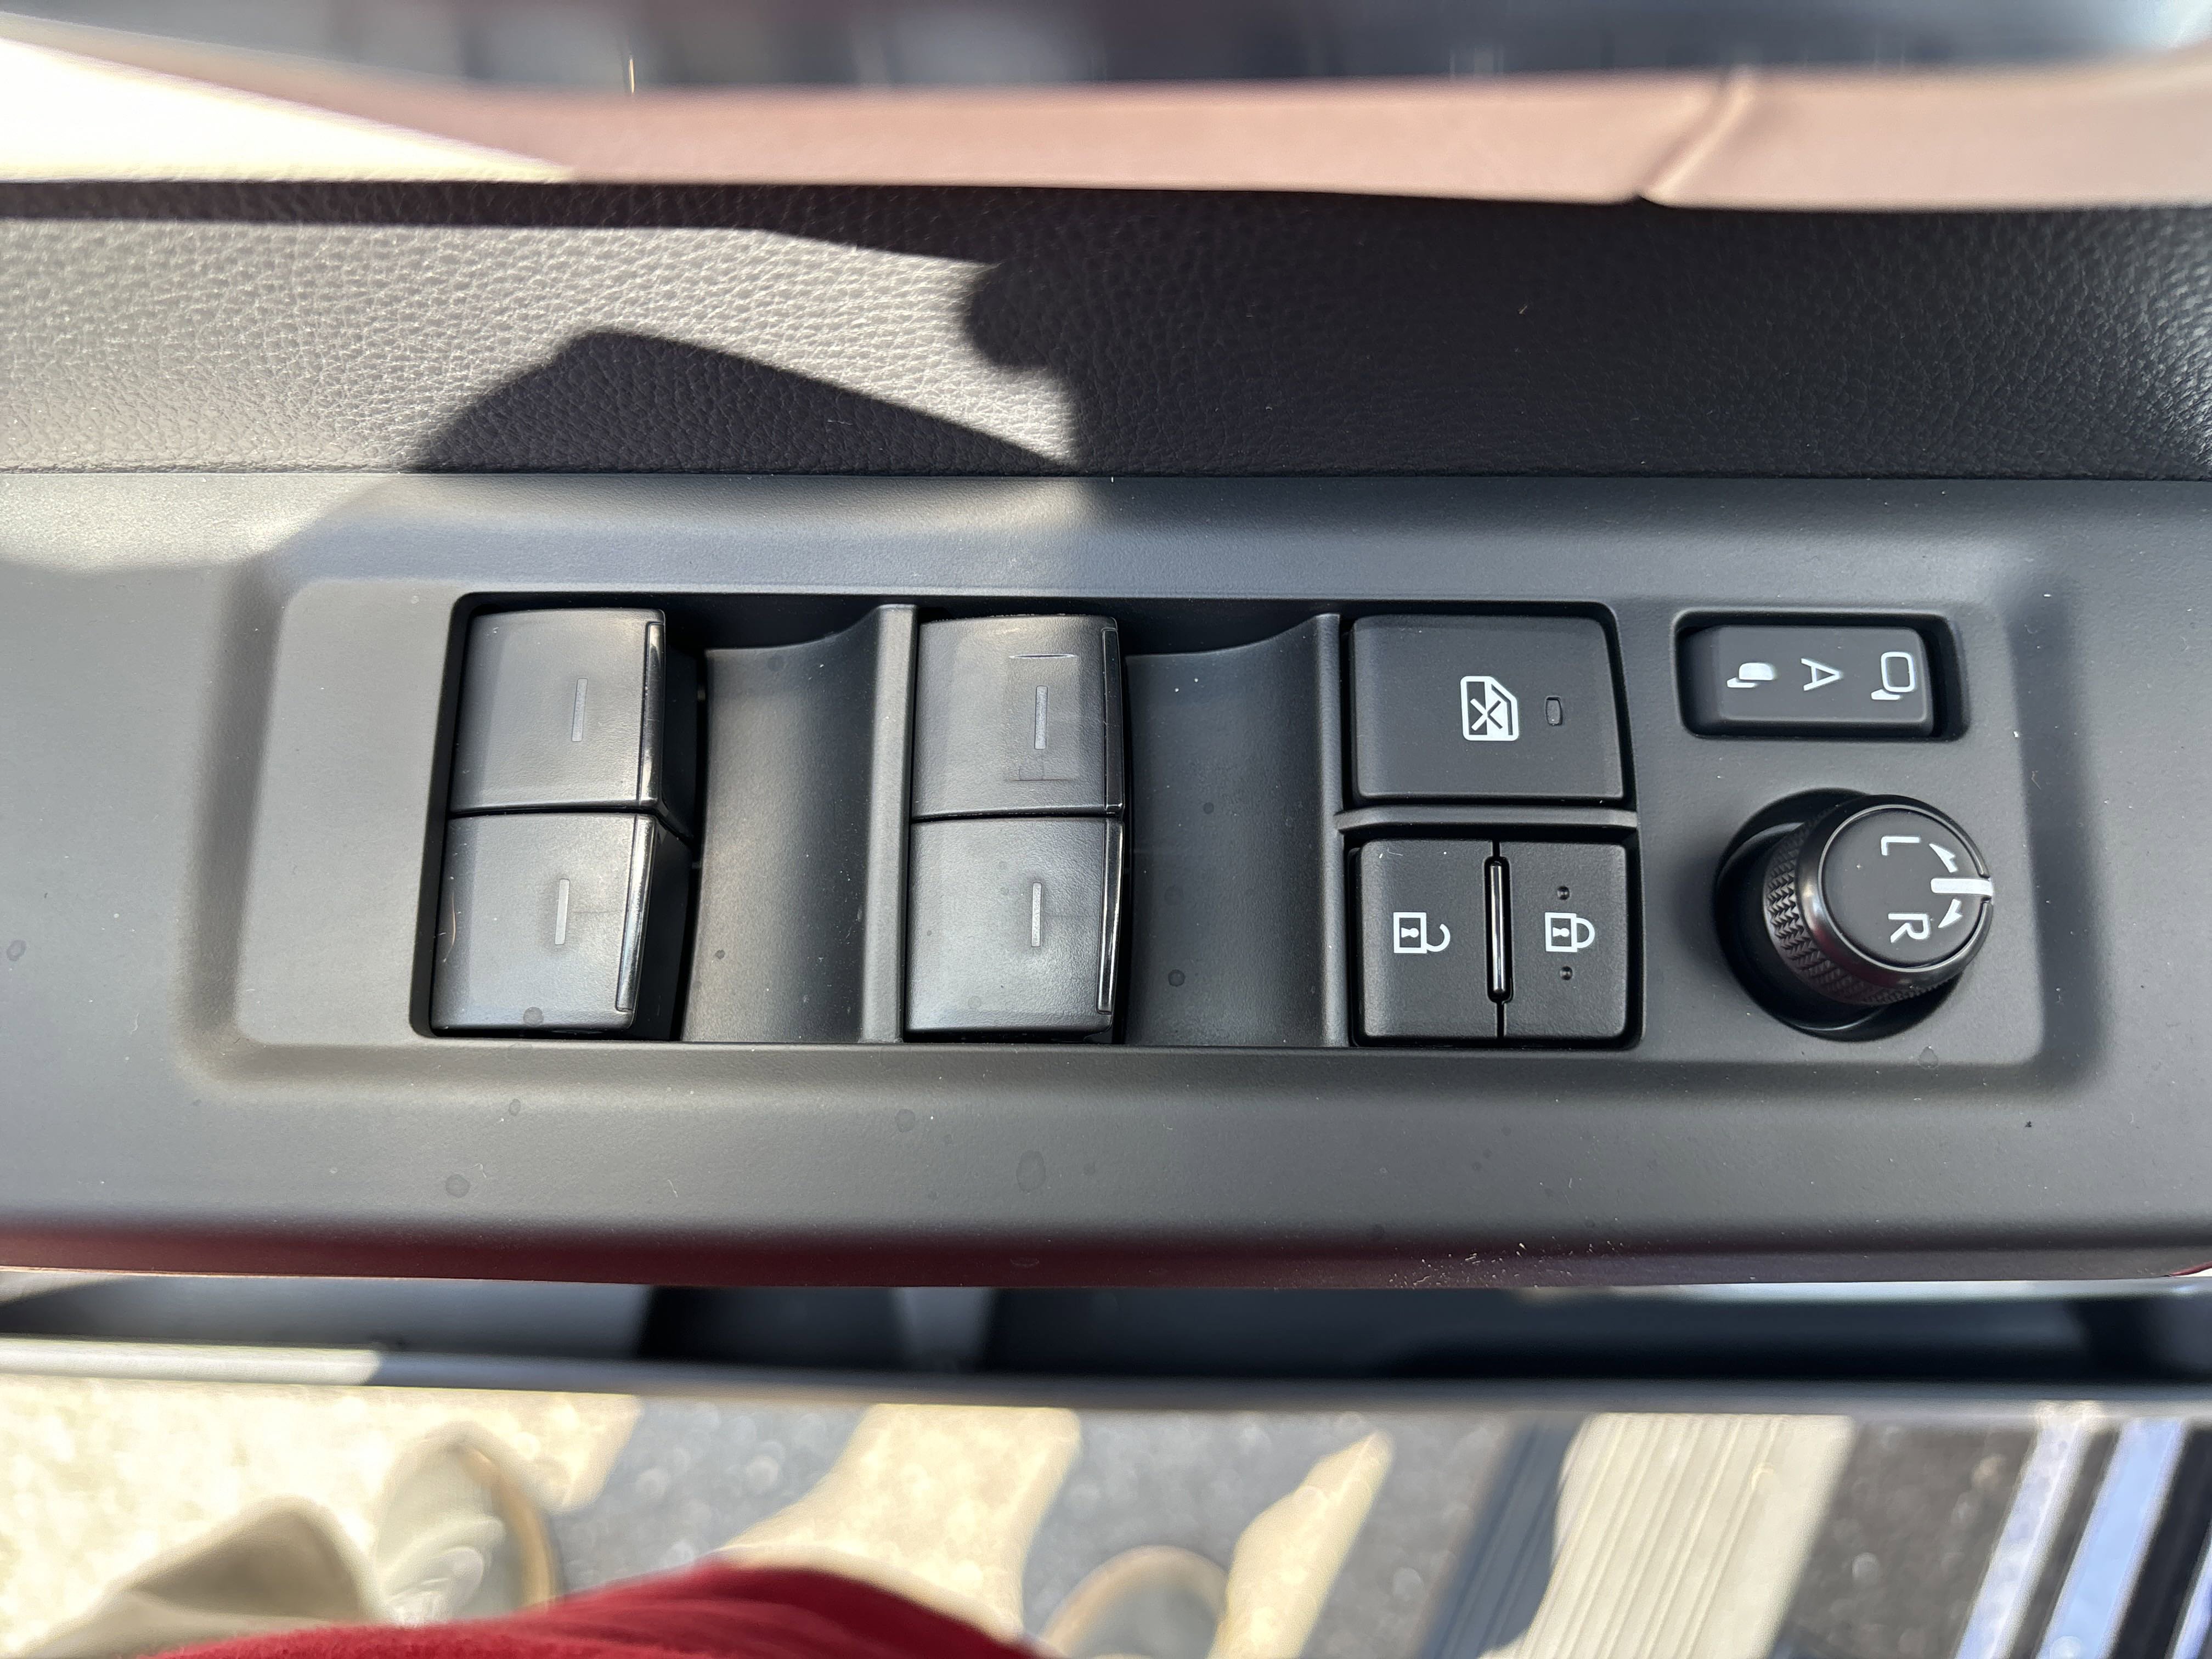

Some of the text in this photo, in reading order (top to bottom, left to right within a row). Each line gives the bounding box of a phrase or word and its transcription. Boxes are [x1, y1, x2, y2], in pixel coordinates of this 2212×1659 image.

[1801, 657, 1843, 691] A
[1881, 836, 1921, 856] L
[1888, 912, 1930, 944] R
